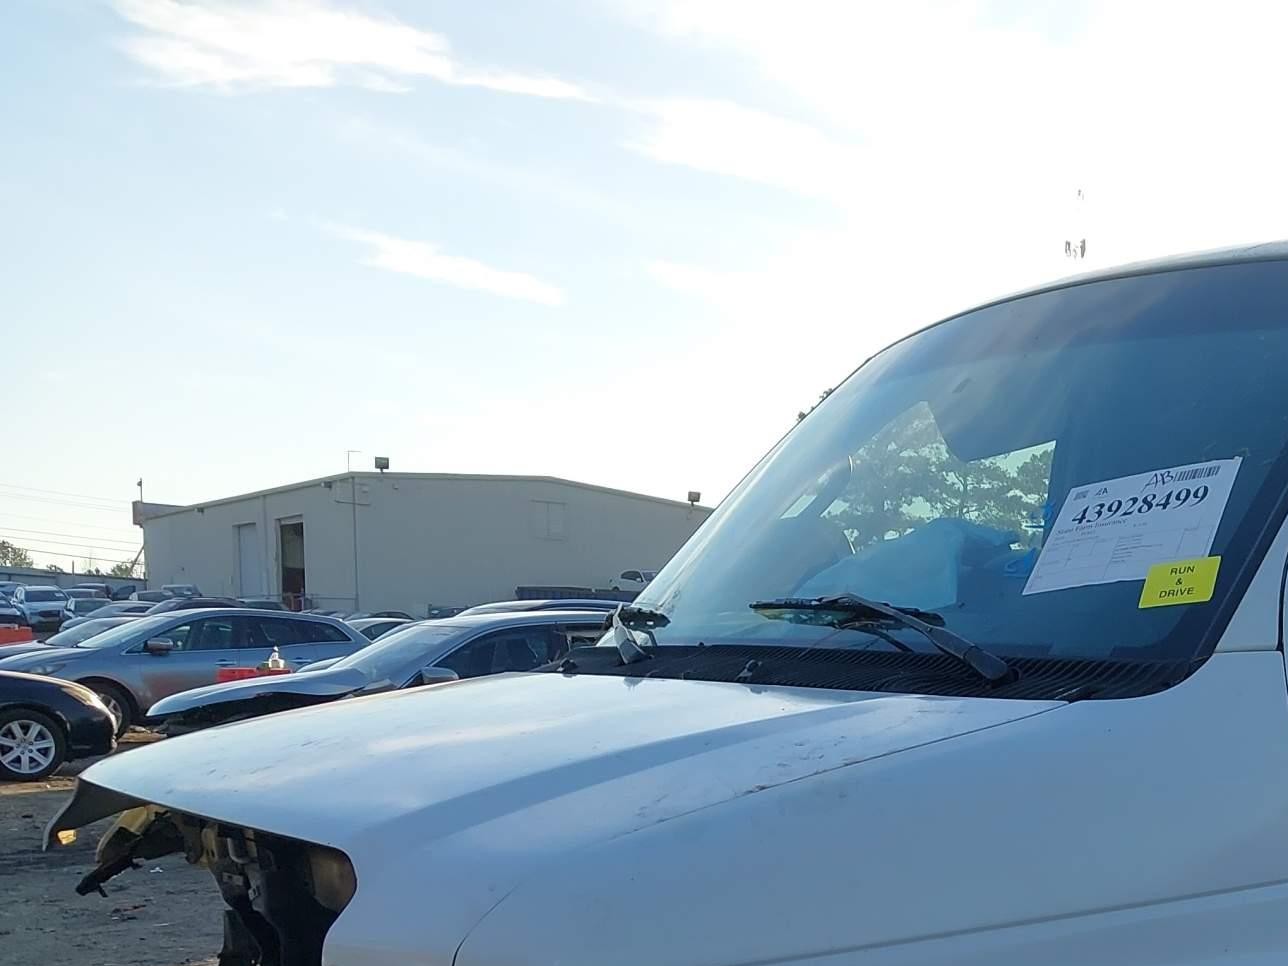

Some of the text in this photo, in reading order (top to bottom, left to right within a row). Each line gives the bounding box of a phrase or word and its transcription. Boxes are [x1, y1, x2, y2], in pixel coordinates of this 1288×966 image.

[1072, 485, 1209, 524] 43928499
[1170, 565, 1195, 576] RUN
[1175, 577, 1182, 586] &
[1159, 586, 1195, 599] DRIVE
